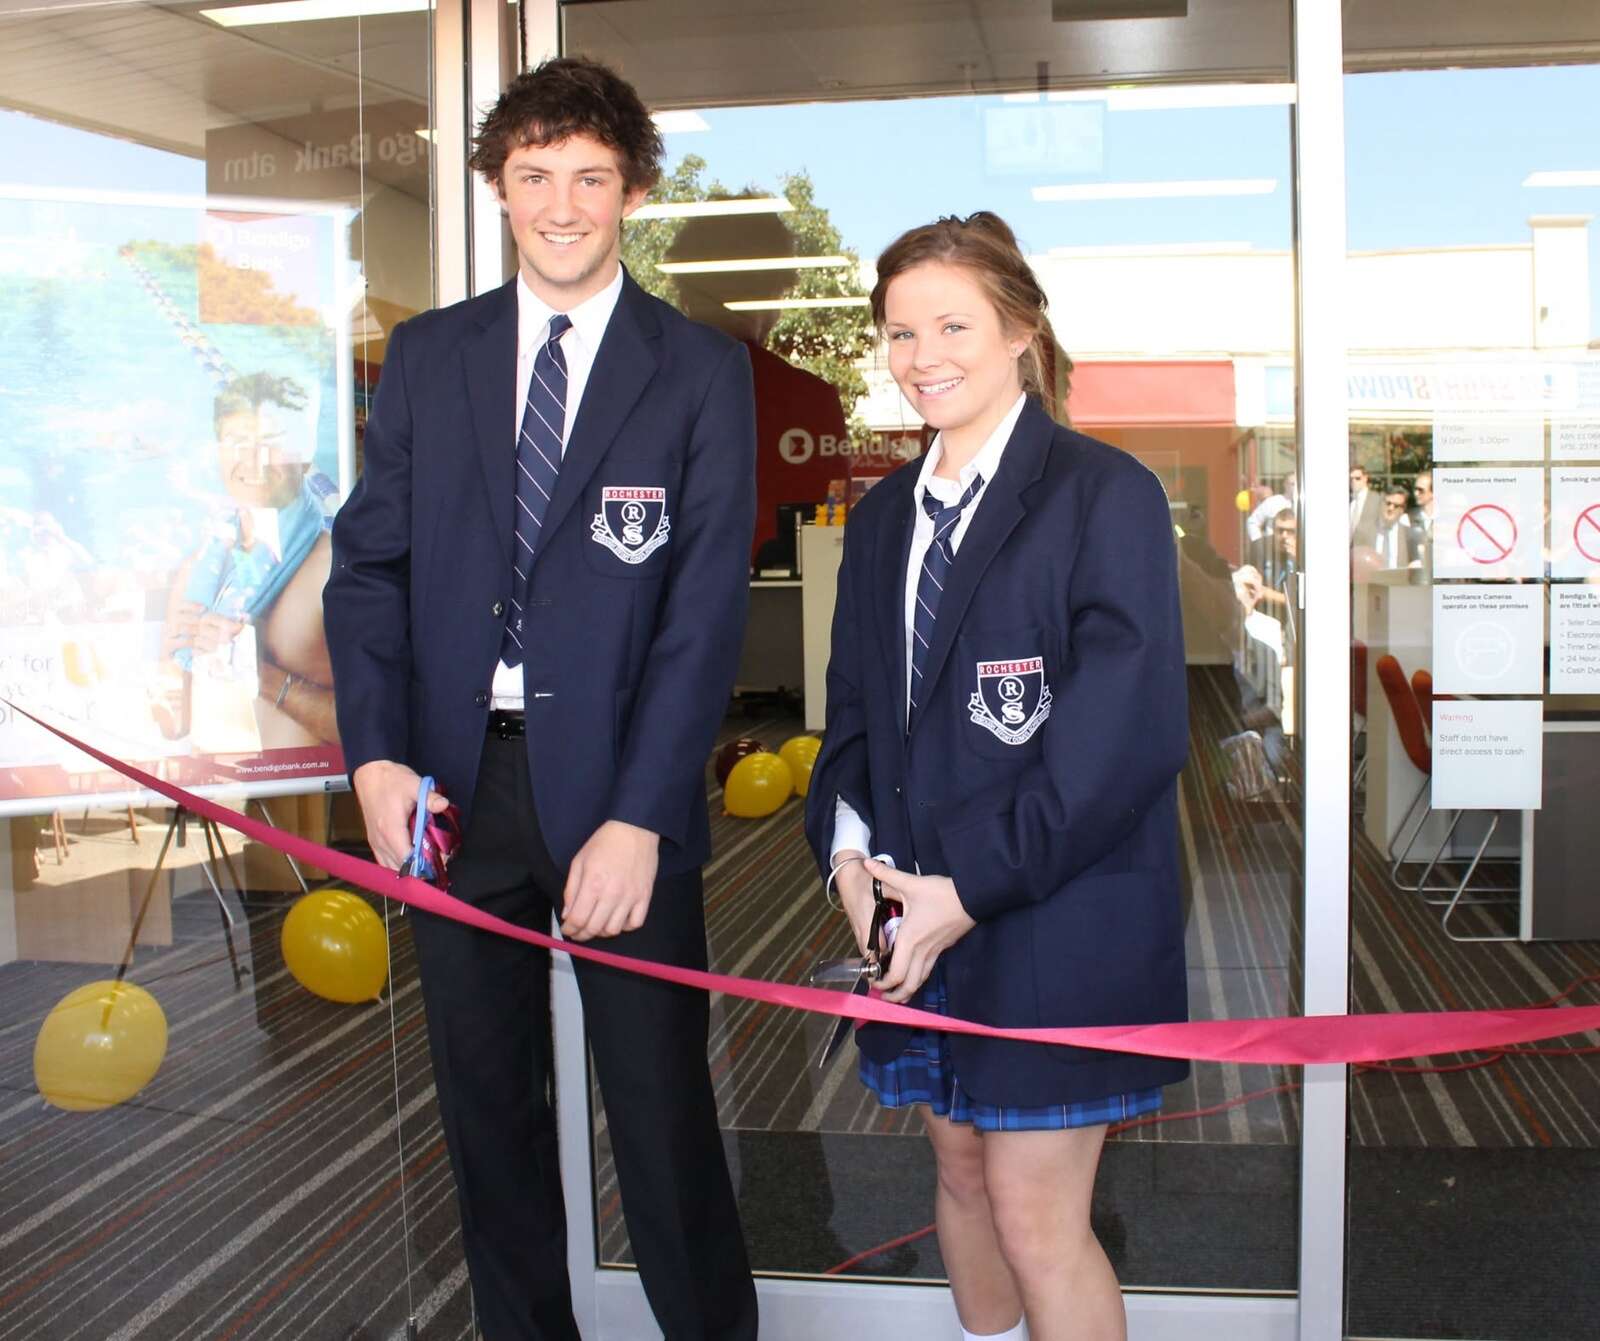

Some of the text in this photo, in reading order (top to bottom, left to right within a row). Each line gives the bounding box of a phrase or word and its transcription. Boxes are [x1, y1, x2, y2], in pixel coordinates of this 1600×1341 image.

[1442, 476, 1517, 484] Please Remove Helmet
[1560, 475, 1590, 485] Smoking
[605, 489, 663, 499] ROCHESTER
[627, 505, 641, 520] R
[622, 524, 644, 545] S
[1442, 593, 1512, 601] Surveillance Cameras
[1560, 592, 1587, 601] Bendigo
[1442, 603, 1467, 611] operate
[1479, 602, 1498, 610] these
[1499, 602, 1528, 611] premises
[24, 653, 54, 673] for
[980, 660, 1041, 675] ROCHESTER
[1567, 666, 1585, 674] Cash
[1003, 681, 1019, 697] R
[1001, 701, 1025, 724] S
[1440, 713, 1473, 723] Warning
[1440, 733, 1509, 742] Staff do not have
[1440, 748, 1462, 756] direct
[1504, 748, 1524, 756] cash
